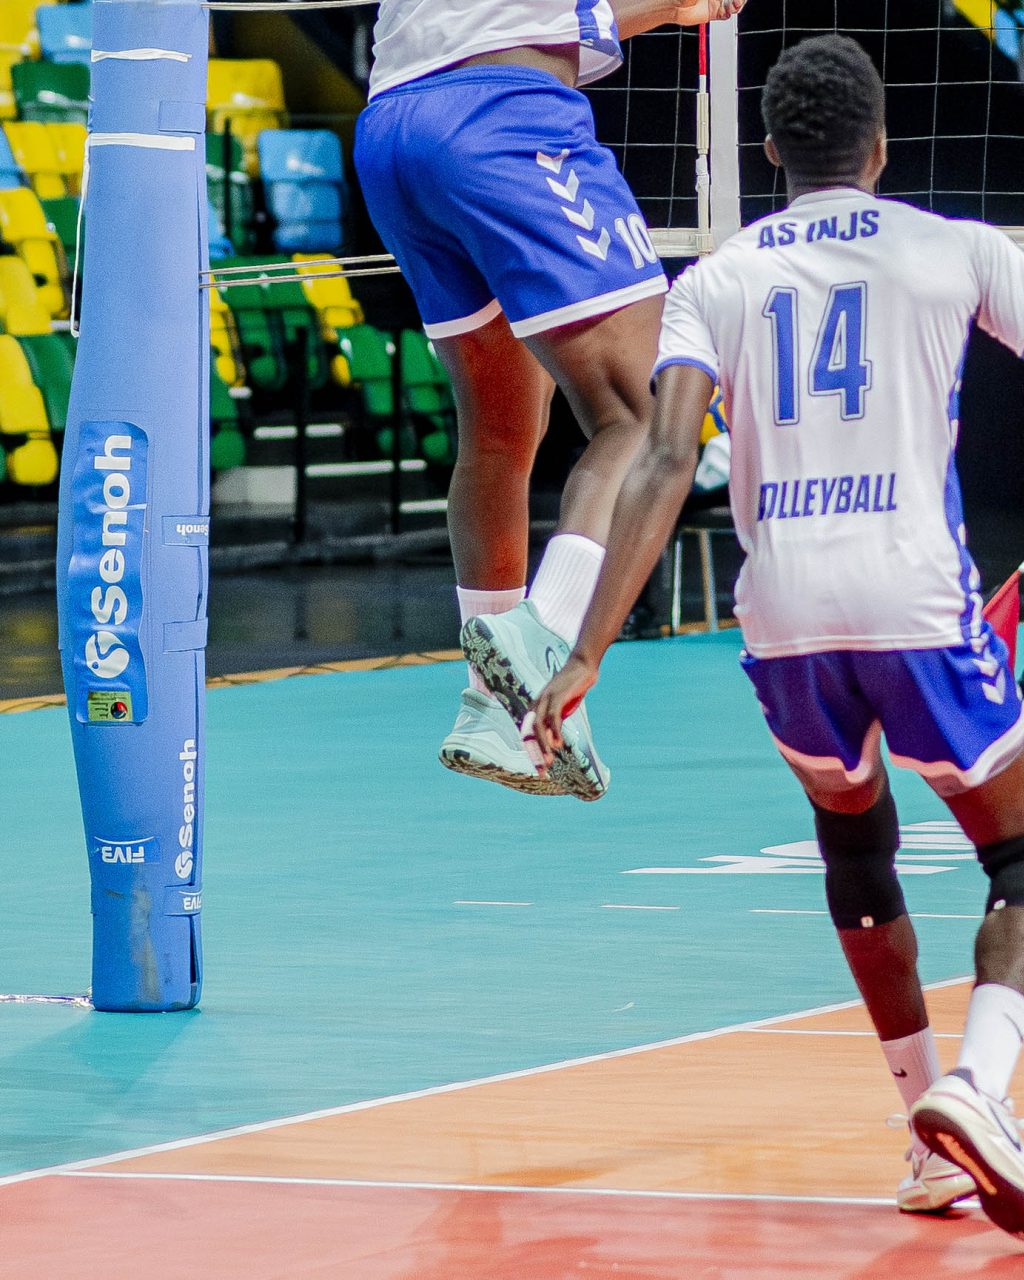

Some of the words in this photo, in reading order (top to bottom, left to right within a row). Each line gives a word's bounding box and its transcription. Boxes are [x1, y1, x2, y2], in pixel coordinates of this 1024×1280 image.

[614, 213, 658, 269] 10
[757, 221, 797, 250] AS
[805, 209, 880, 244] INJS
[762, 280, 872, 427] 14
[757, 472, 897, 520] OLLEYBALL
[101, 845, 145, 863] FIVB
